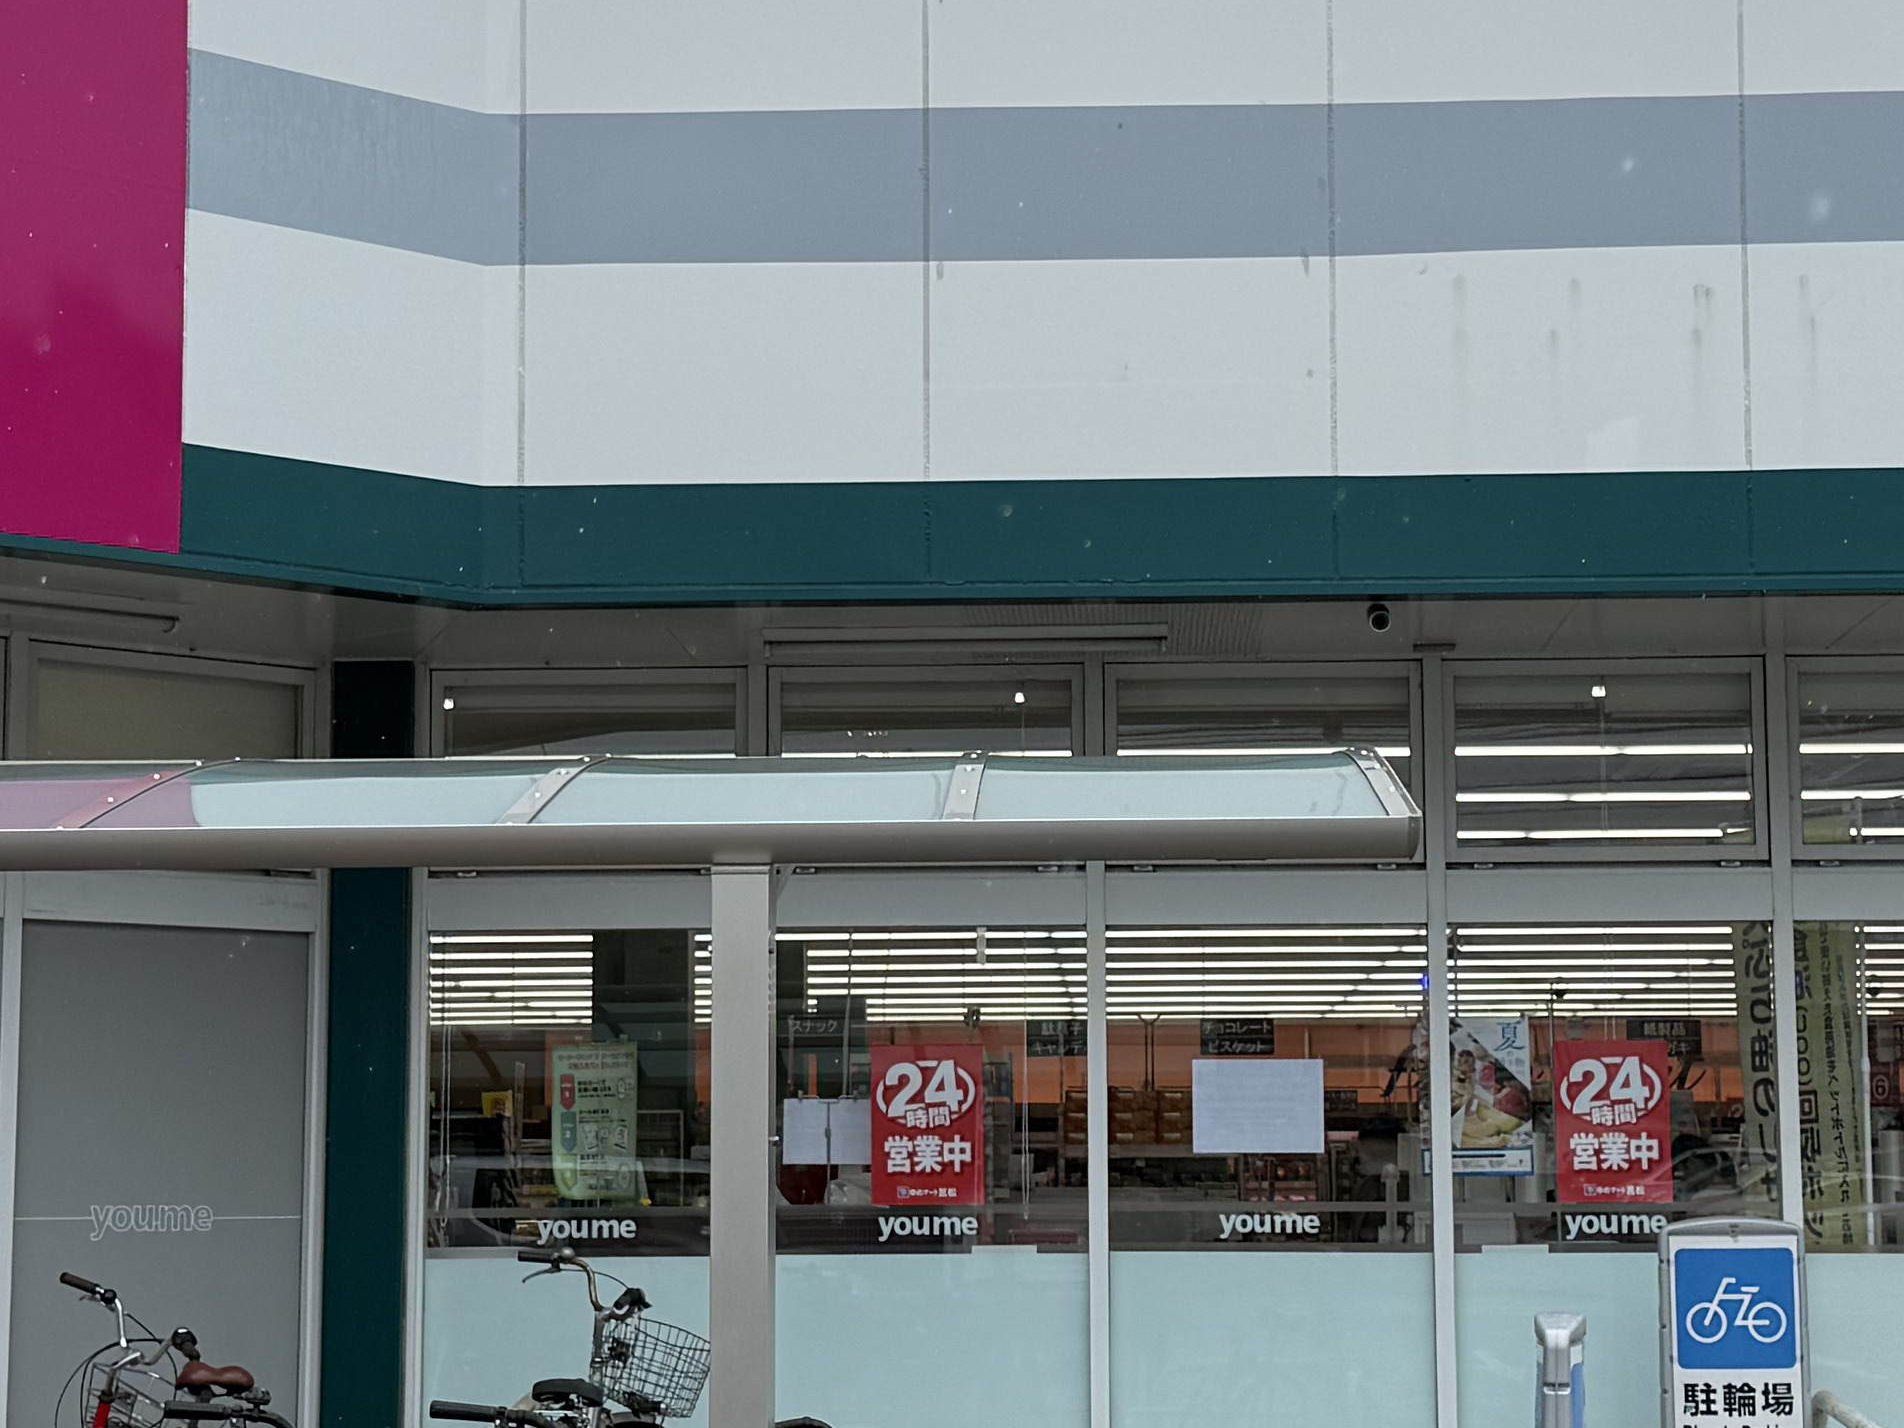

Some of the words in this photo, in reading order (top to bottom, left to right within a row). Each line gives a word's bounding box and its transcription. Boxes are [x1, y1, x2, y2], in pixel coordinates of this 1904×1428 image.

[1204, 1021, 1272, 1034] チョコレート
[1494, 1020, 1526, 1052] 夏
[1208, 1039, 1266, 1054] ビスケット
[884, 1059, 963, 1119] 24
[1569, 1056, 1650, 1115] 24
[905, 1106, 951, 1129] 時間
[1590, 1103, 1637, 1126] 時間
[884, 1134, 972, 1173] 営業中
[1569, 1132, 1660, 1171] 営業中
[90, 1202, 214, 1240] youme
[537, 1217, 637, 1245] youme
[878, 1215, 978, 1242] youme
[1219, 1211, 1320, 1238] youme
[1565, 1213, 1669, 1240] youme
[1682, 1382, 1795, 1418] 駐輪場
